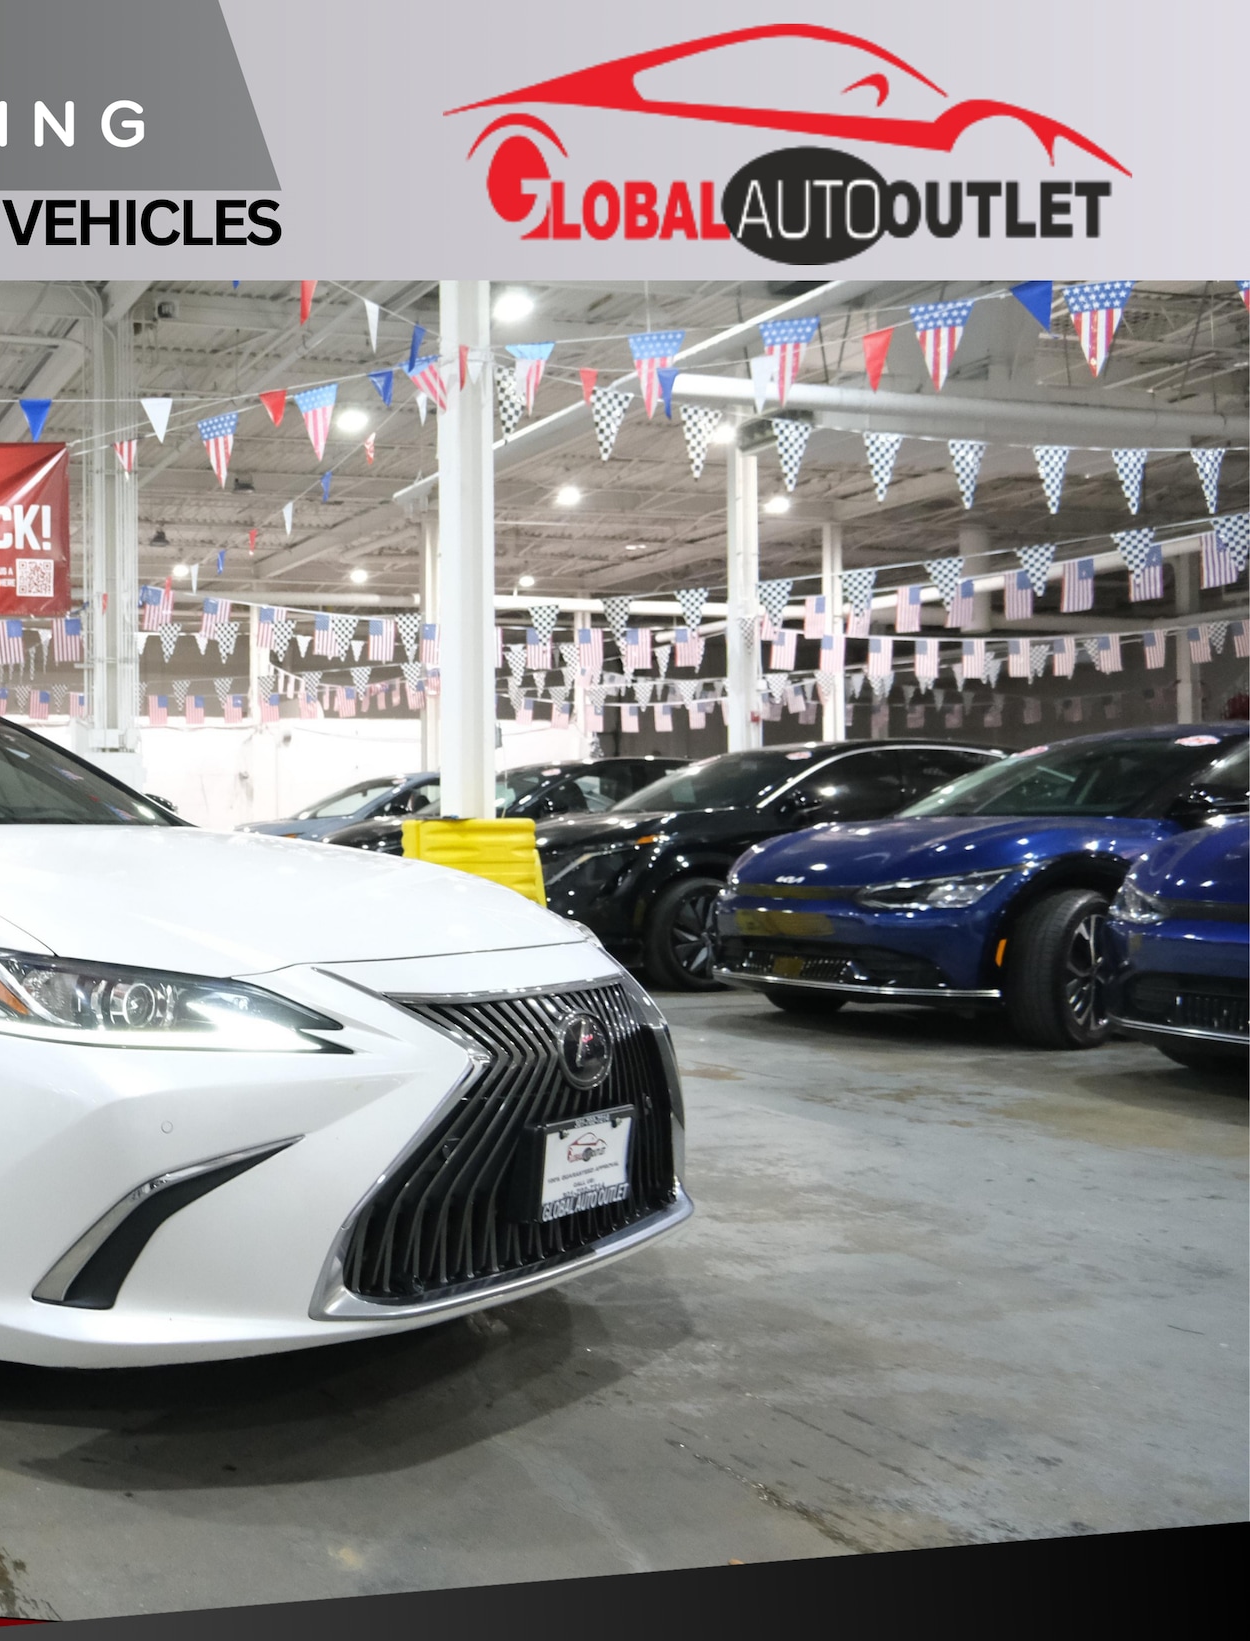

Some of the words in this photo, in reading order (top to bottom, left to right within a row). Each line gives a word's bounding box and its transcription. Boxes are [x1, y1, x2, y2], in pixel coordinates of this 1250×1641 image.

[542, 1199, 576, 1222] GLOBAL
[574, 1190, 598, 1212] AUTO
[597, 1182, 629, 1206] OUTLET
